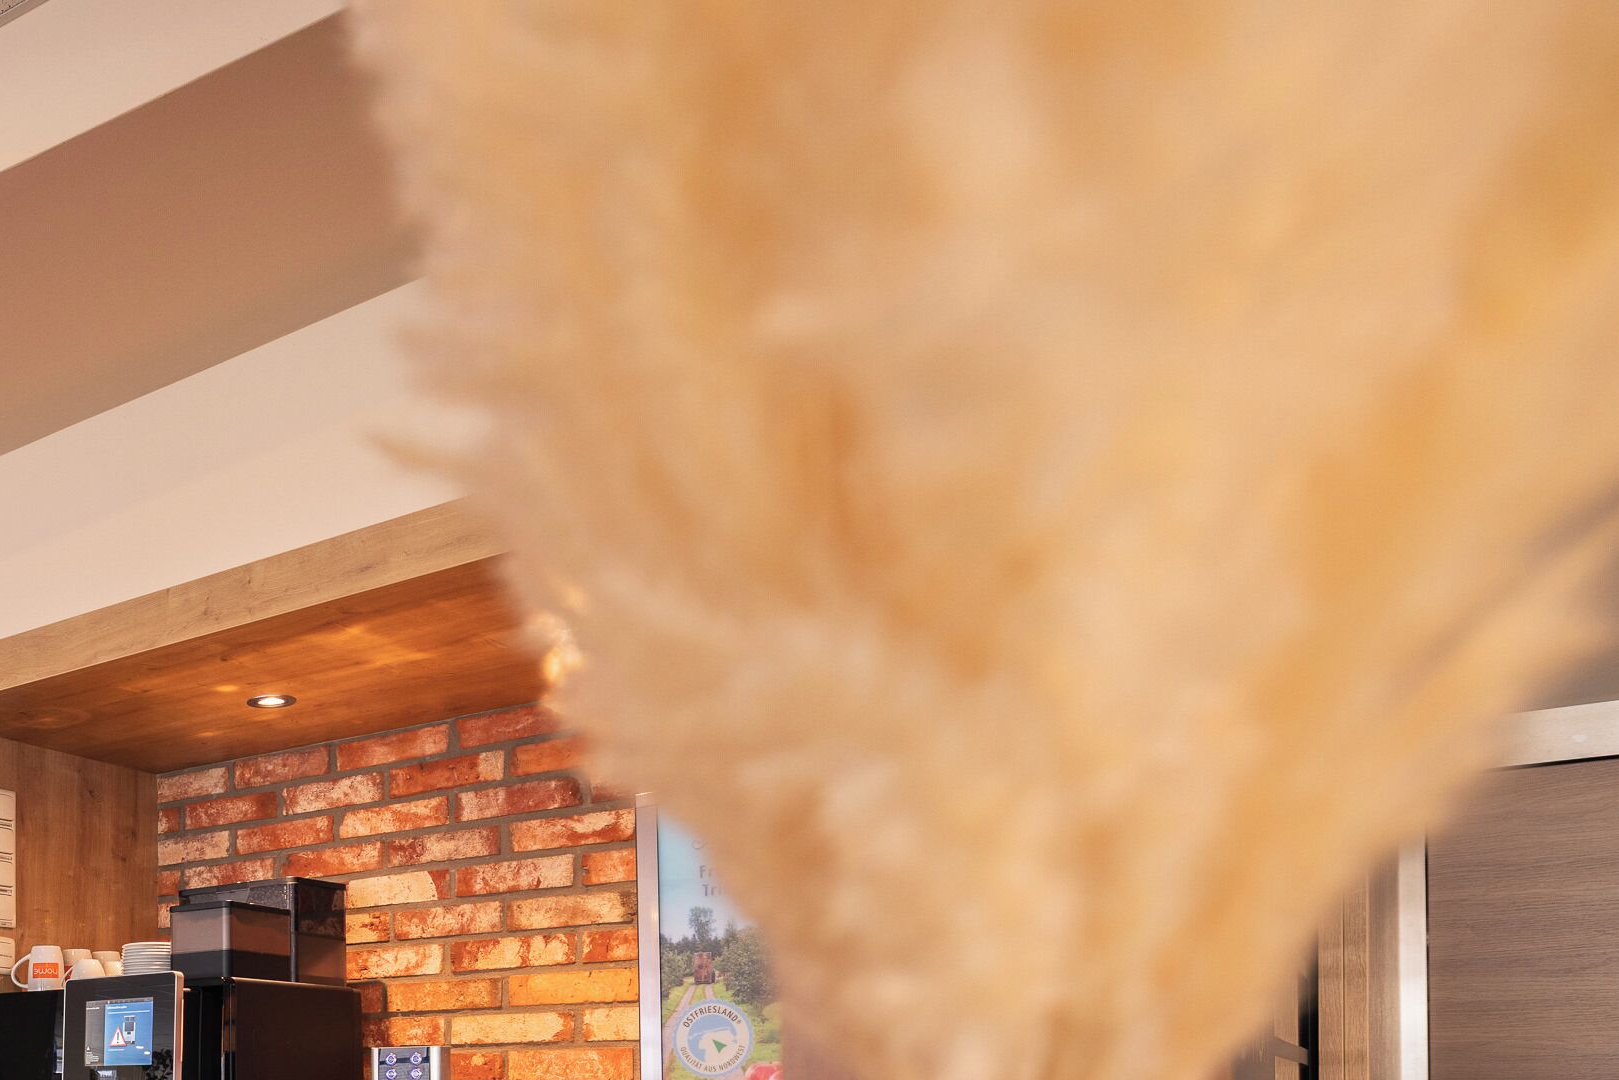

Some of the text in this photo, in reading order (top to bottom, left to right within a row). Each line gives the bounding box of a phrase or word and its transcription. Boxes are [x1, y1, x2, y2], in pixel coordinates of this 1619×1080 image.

[680, 1044, 747, 1073] QUALITÄT AUS NORDWEST
